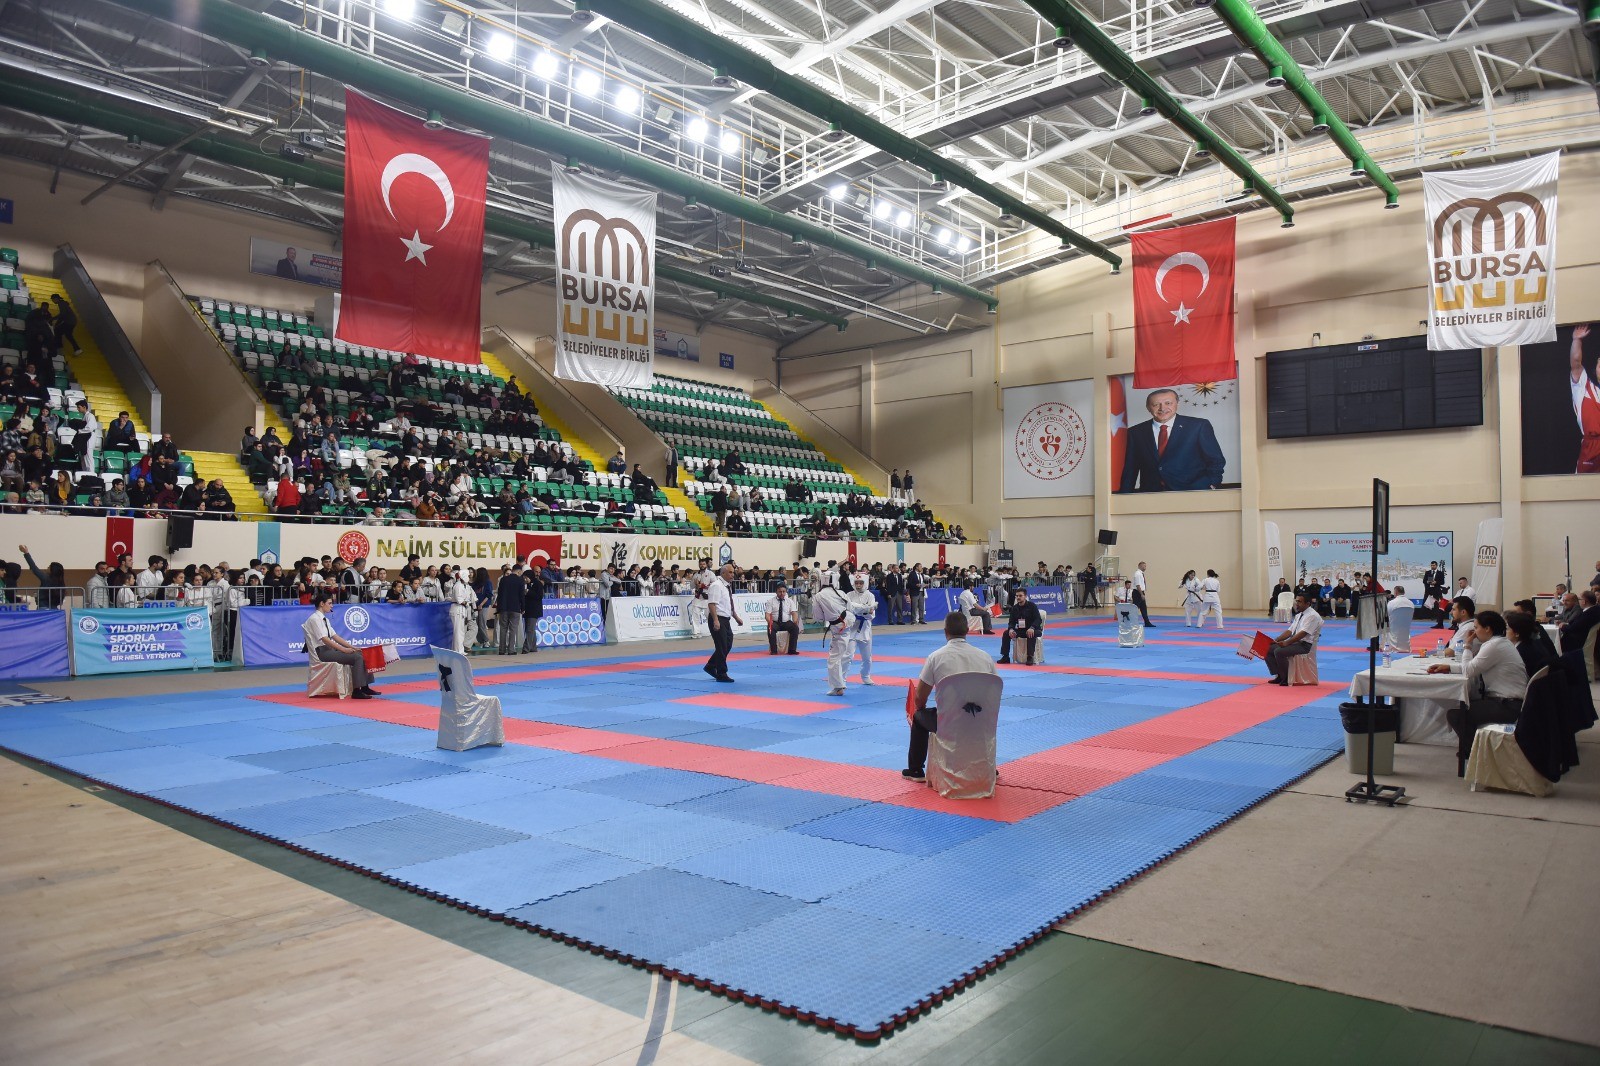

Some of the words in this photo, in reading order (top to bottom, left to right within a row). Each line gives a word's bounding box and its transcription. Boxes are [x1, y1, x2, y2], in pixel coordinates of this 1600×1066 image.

[1434, 251, 1546, 284] BURSA
[561, 273, 648, 314] BURSA
[1435, 312, 1503, 327] BELEDİYELER
[1506, 305, 1547, 322] BİRLİĞİ
[563, 340, 619, 359] BELEDİYELER
[620, 347, 650, 363] BİRLİĞİ
[376, 535, 433, 558] NAİM
[109, 633, 156, 643] SPORLA
[110, 642, 166, 653] BÜYÜYEN
[111, 654, 124, 662] BİR
[124, 653, 145, 661] NESİL
[145, 651, 182, 660] YETİŞİYOR
